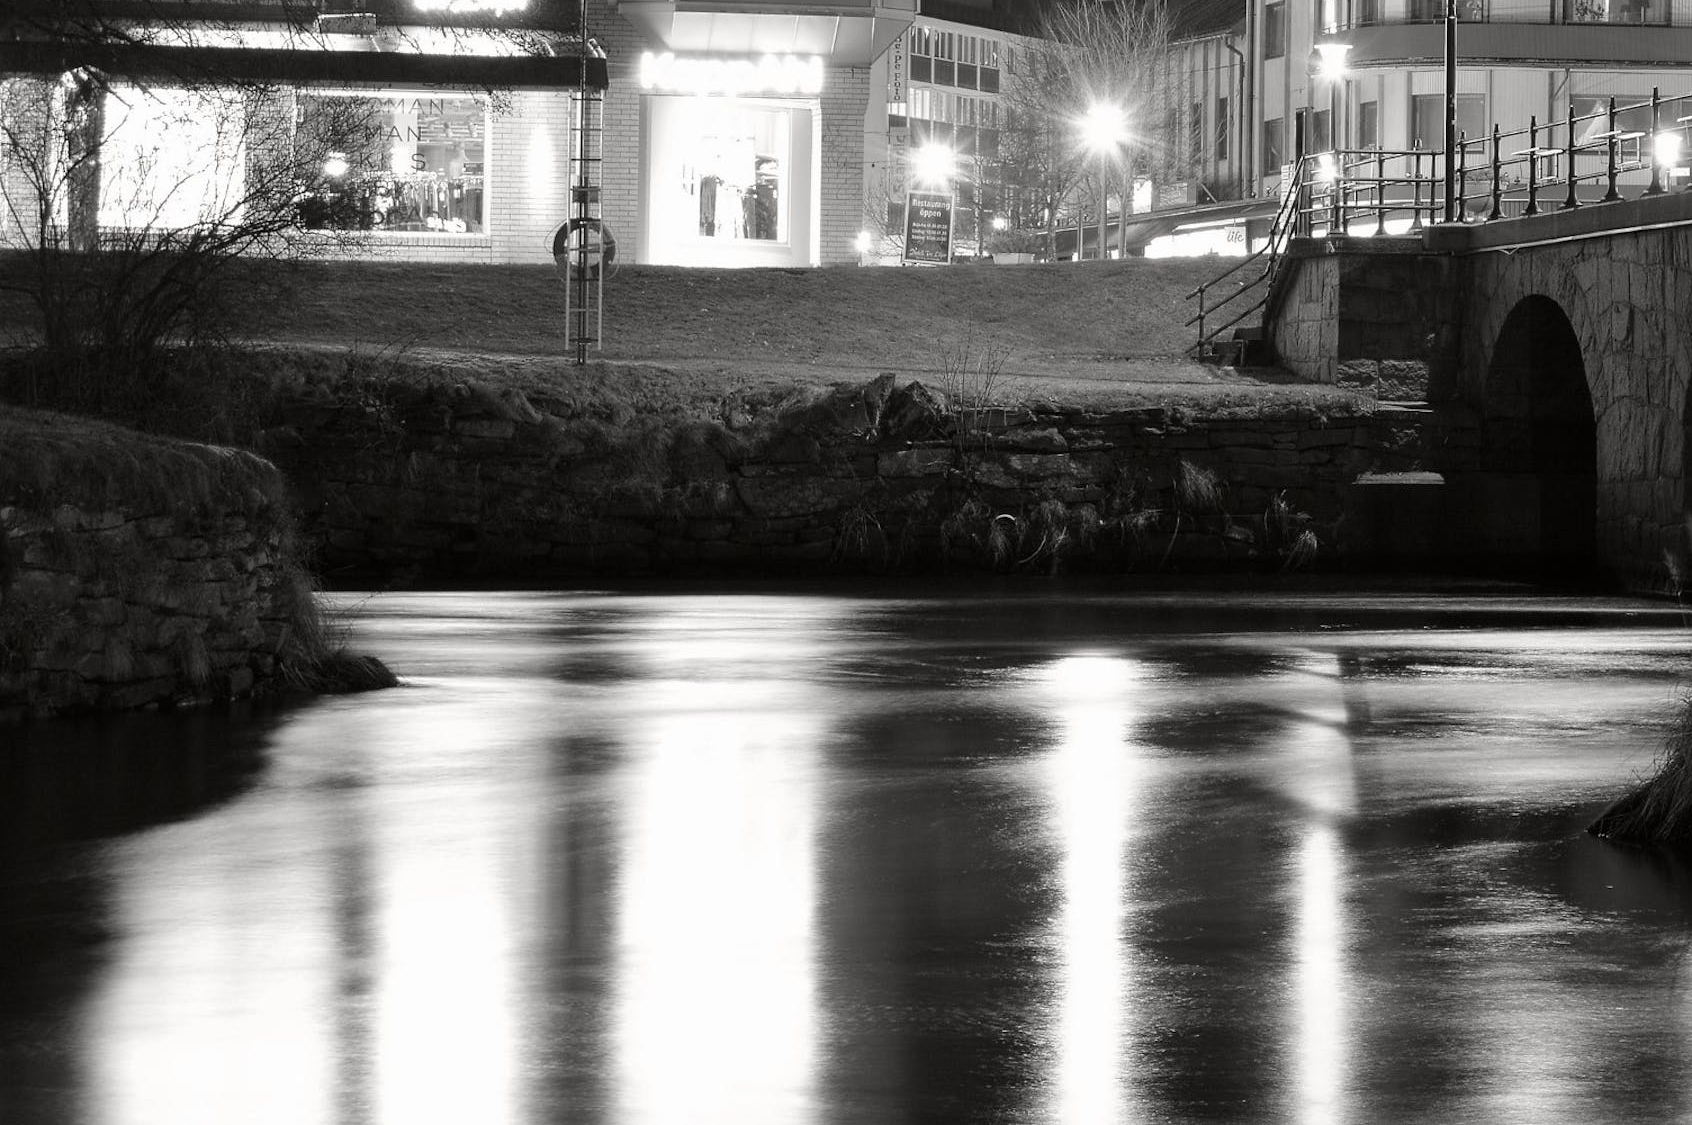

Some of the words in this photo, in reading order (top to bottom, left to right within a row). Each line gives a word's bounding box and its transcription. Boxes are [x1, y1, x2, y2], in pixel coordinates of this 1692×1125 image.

[364, 125, 421, 142] MAN
[360, 152, 426, 171] KIS
[912, 198, 951, 211] Restaurang
